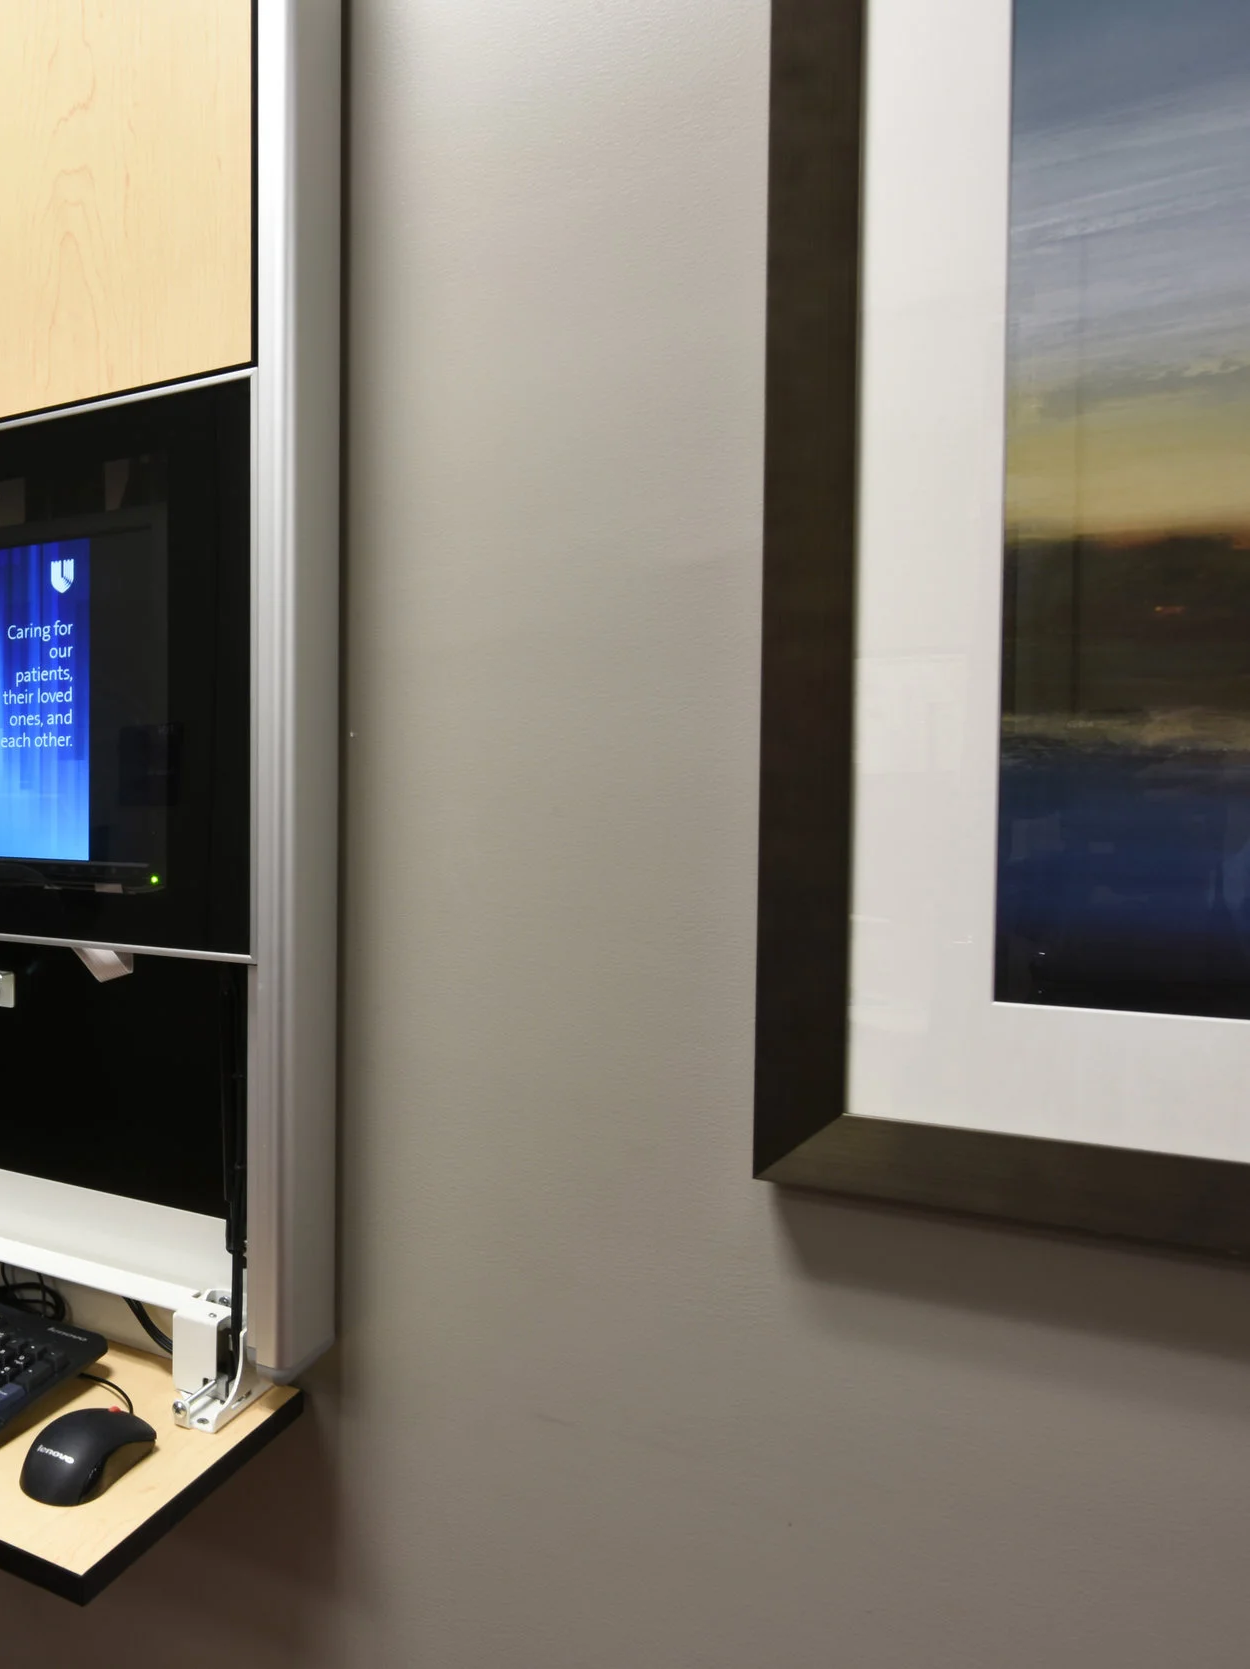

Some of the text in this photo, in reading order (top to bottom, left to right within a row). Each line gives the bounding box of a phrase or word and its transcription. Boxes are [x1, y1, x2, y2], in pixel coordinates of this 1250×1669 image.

[7, 620, 73, 642] Caring for
[49, 646, 73, 658] our
[16, 666, 73, 687] patients,
[3, 686, 72, 705] their loved
[9, 709, 72, 727] ones, and
[1, 732, 73, 748] each other.
[37, 1444, 74, 1464] lenovo
